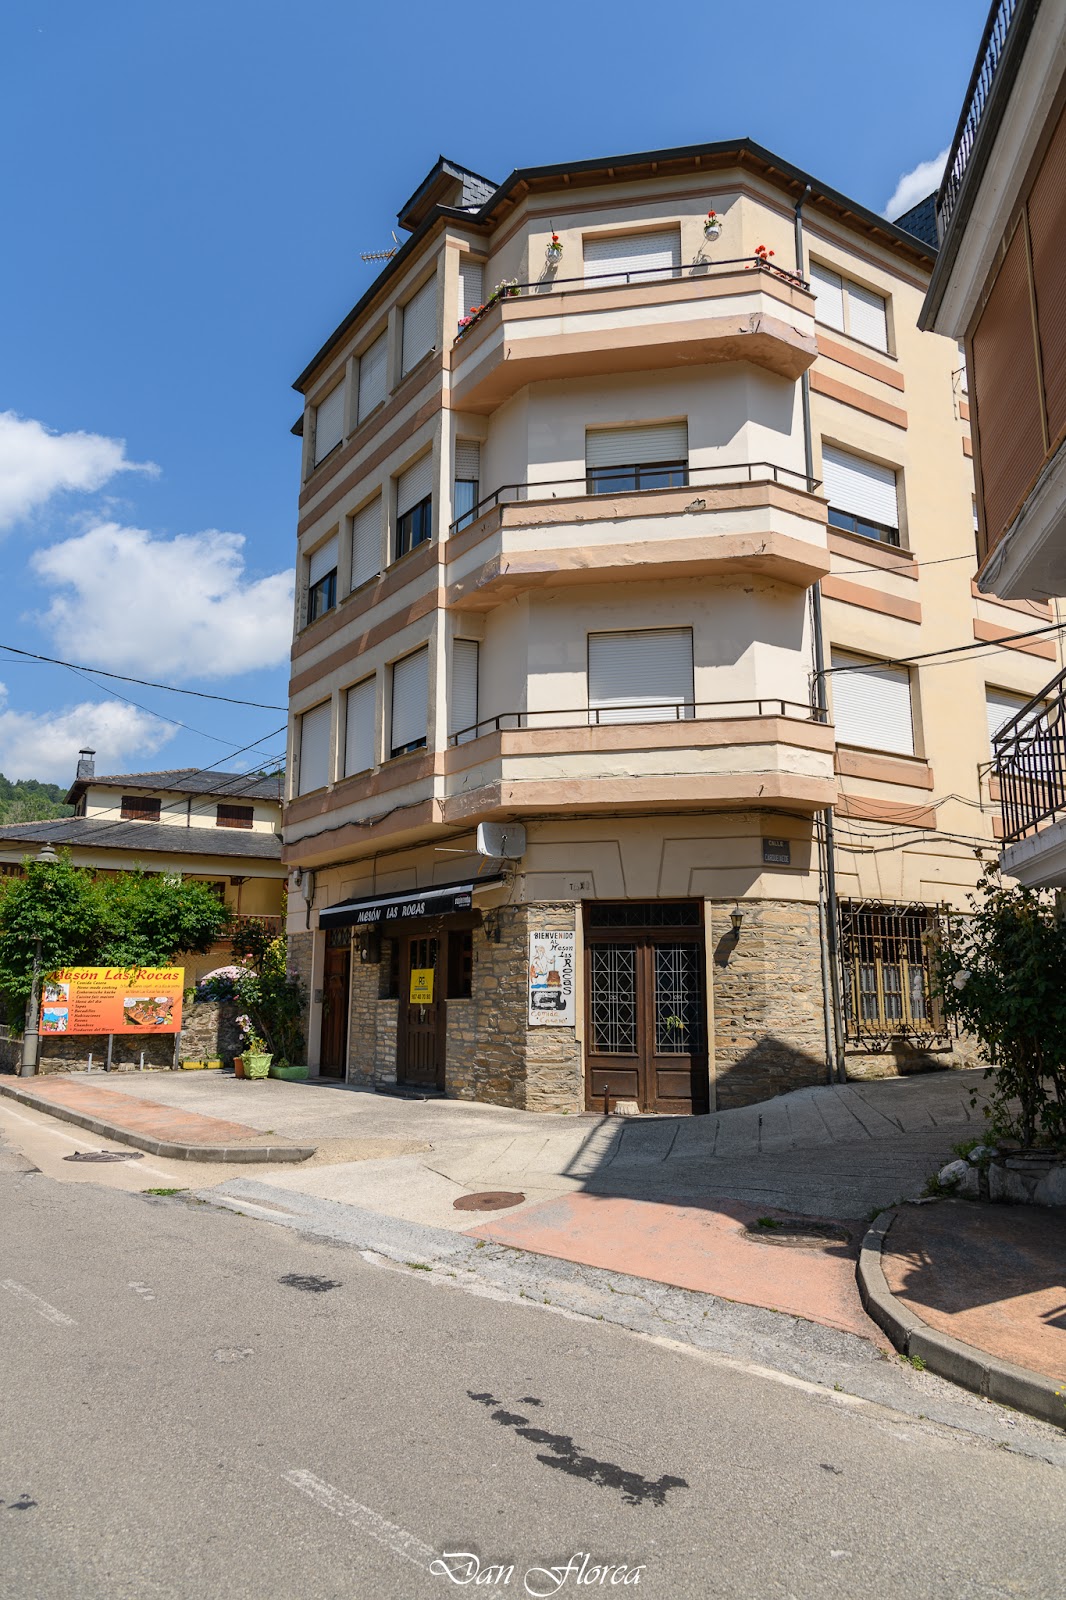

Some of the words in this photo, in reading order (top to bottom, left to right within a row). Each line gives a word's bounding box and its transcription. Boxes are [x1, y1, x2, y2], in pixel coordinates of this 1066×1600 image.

[386, 906, 398, 919] LAS
[401, 902, 425, 917] ROCAS
[534, 932, 573, 940] BIENVENIDO
[104, 969, 130, 980] Las
[135, 969, 180, 980] Rocas
